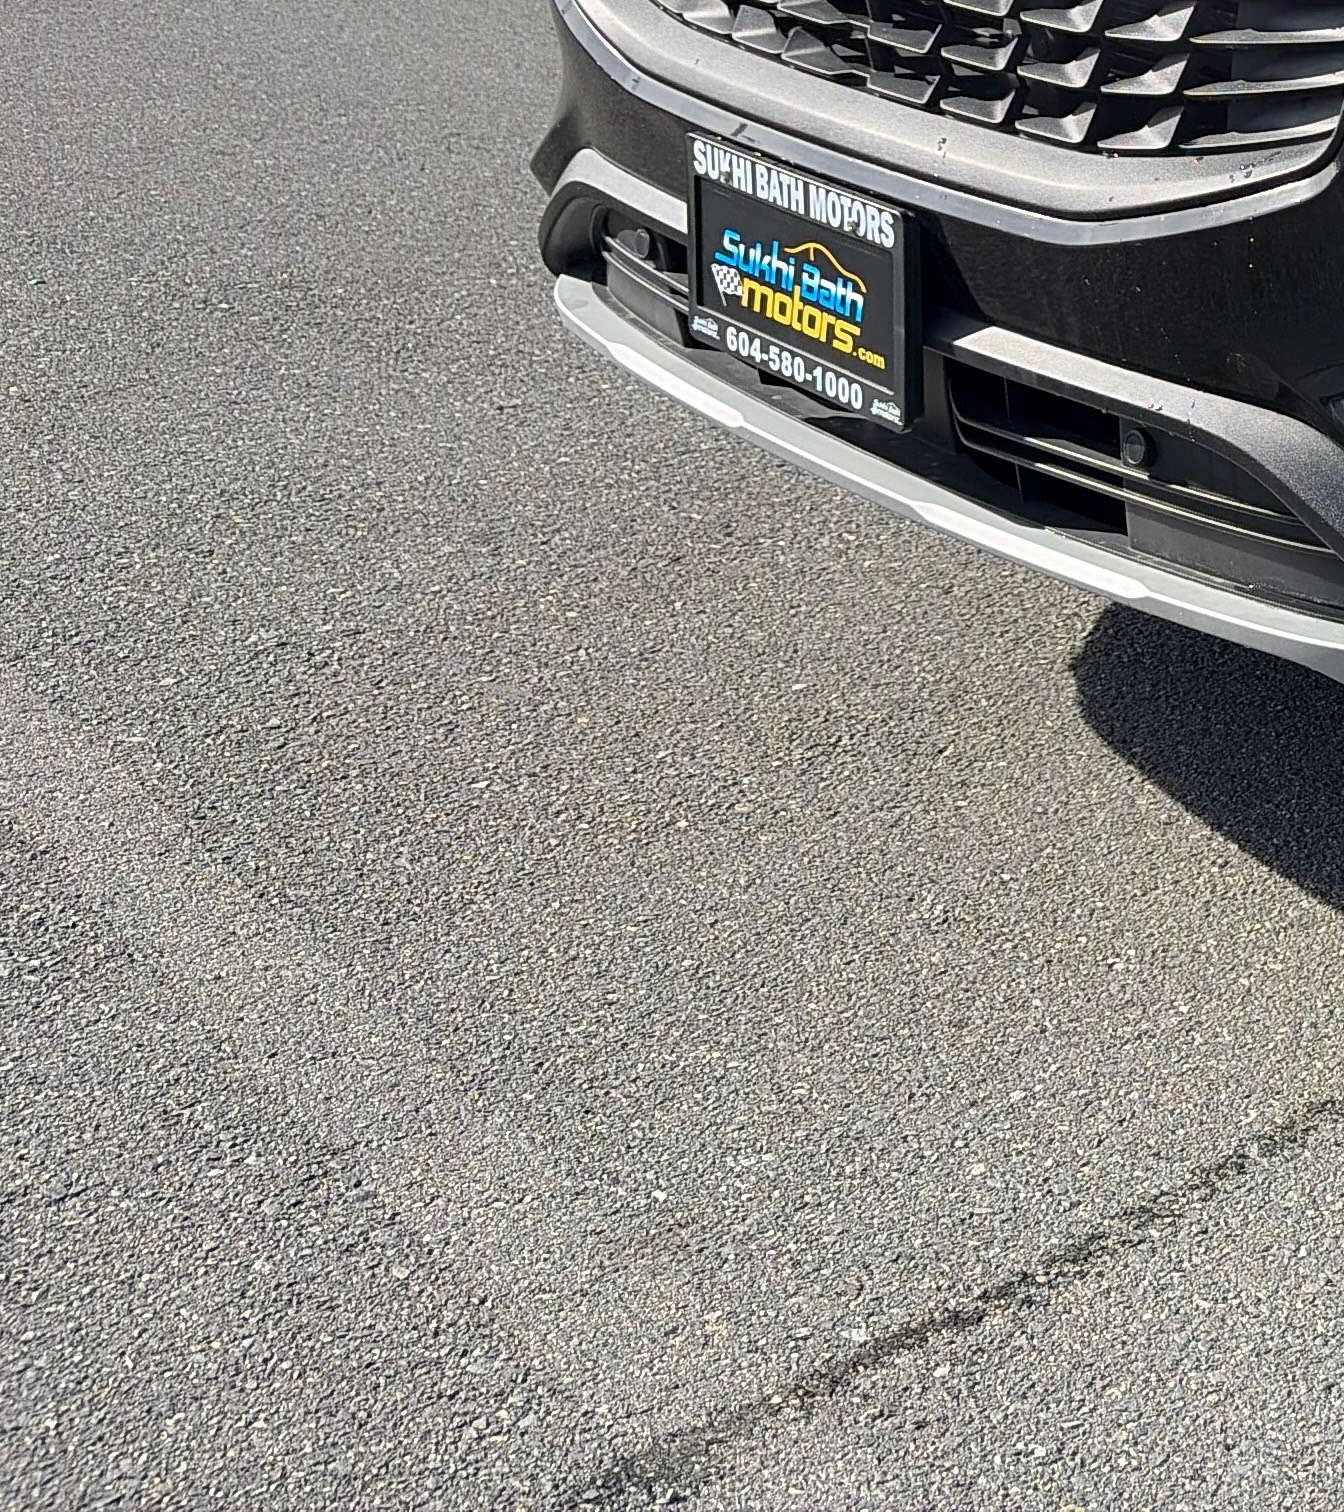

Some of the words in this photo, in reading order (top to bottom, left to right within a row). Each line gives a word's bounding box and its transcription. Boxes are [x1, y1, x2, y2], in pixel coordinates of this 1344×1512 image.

[693, 139, 753, 194] SUKHI
[756, 168, 805, 215] BATH
[809, 187, 895, 248] MOTORS
[714, 228, 795, 292] Sukhi
[801, 263, 865, 323] Bath
[726, 326, 863, 409] 604-580-1000
